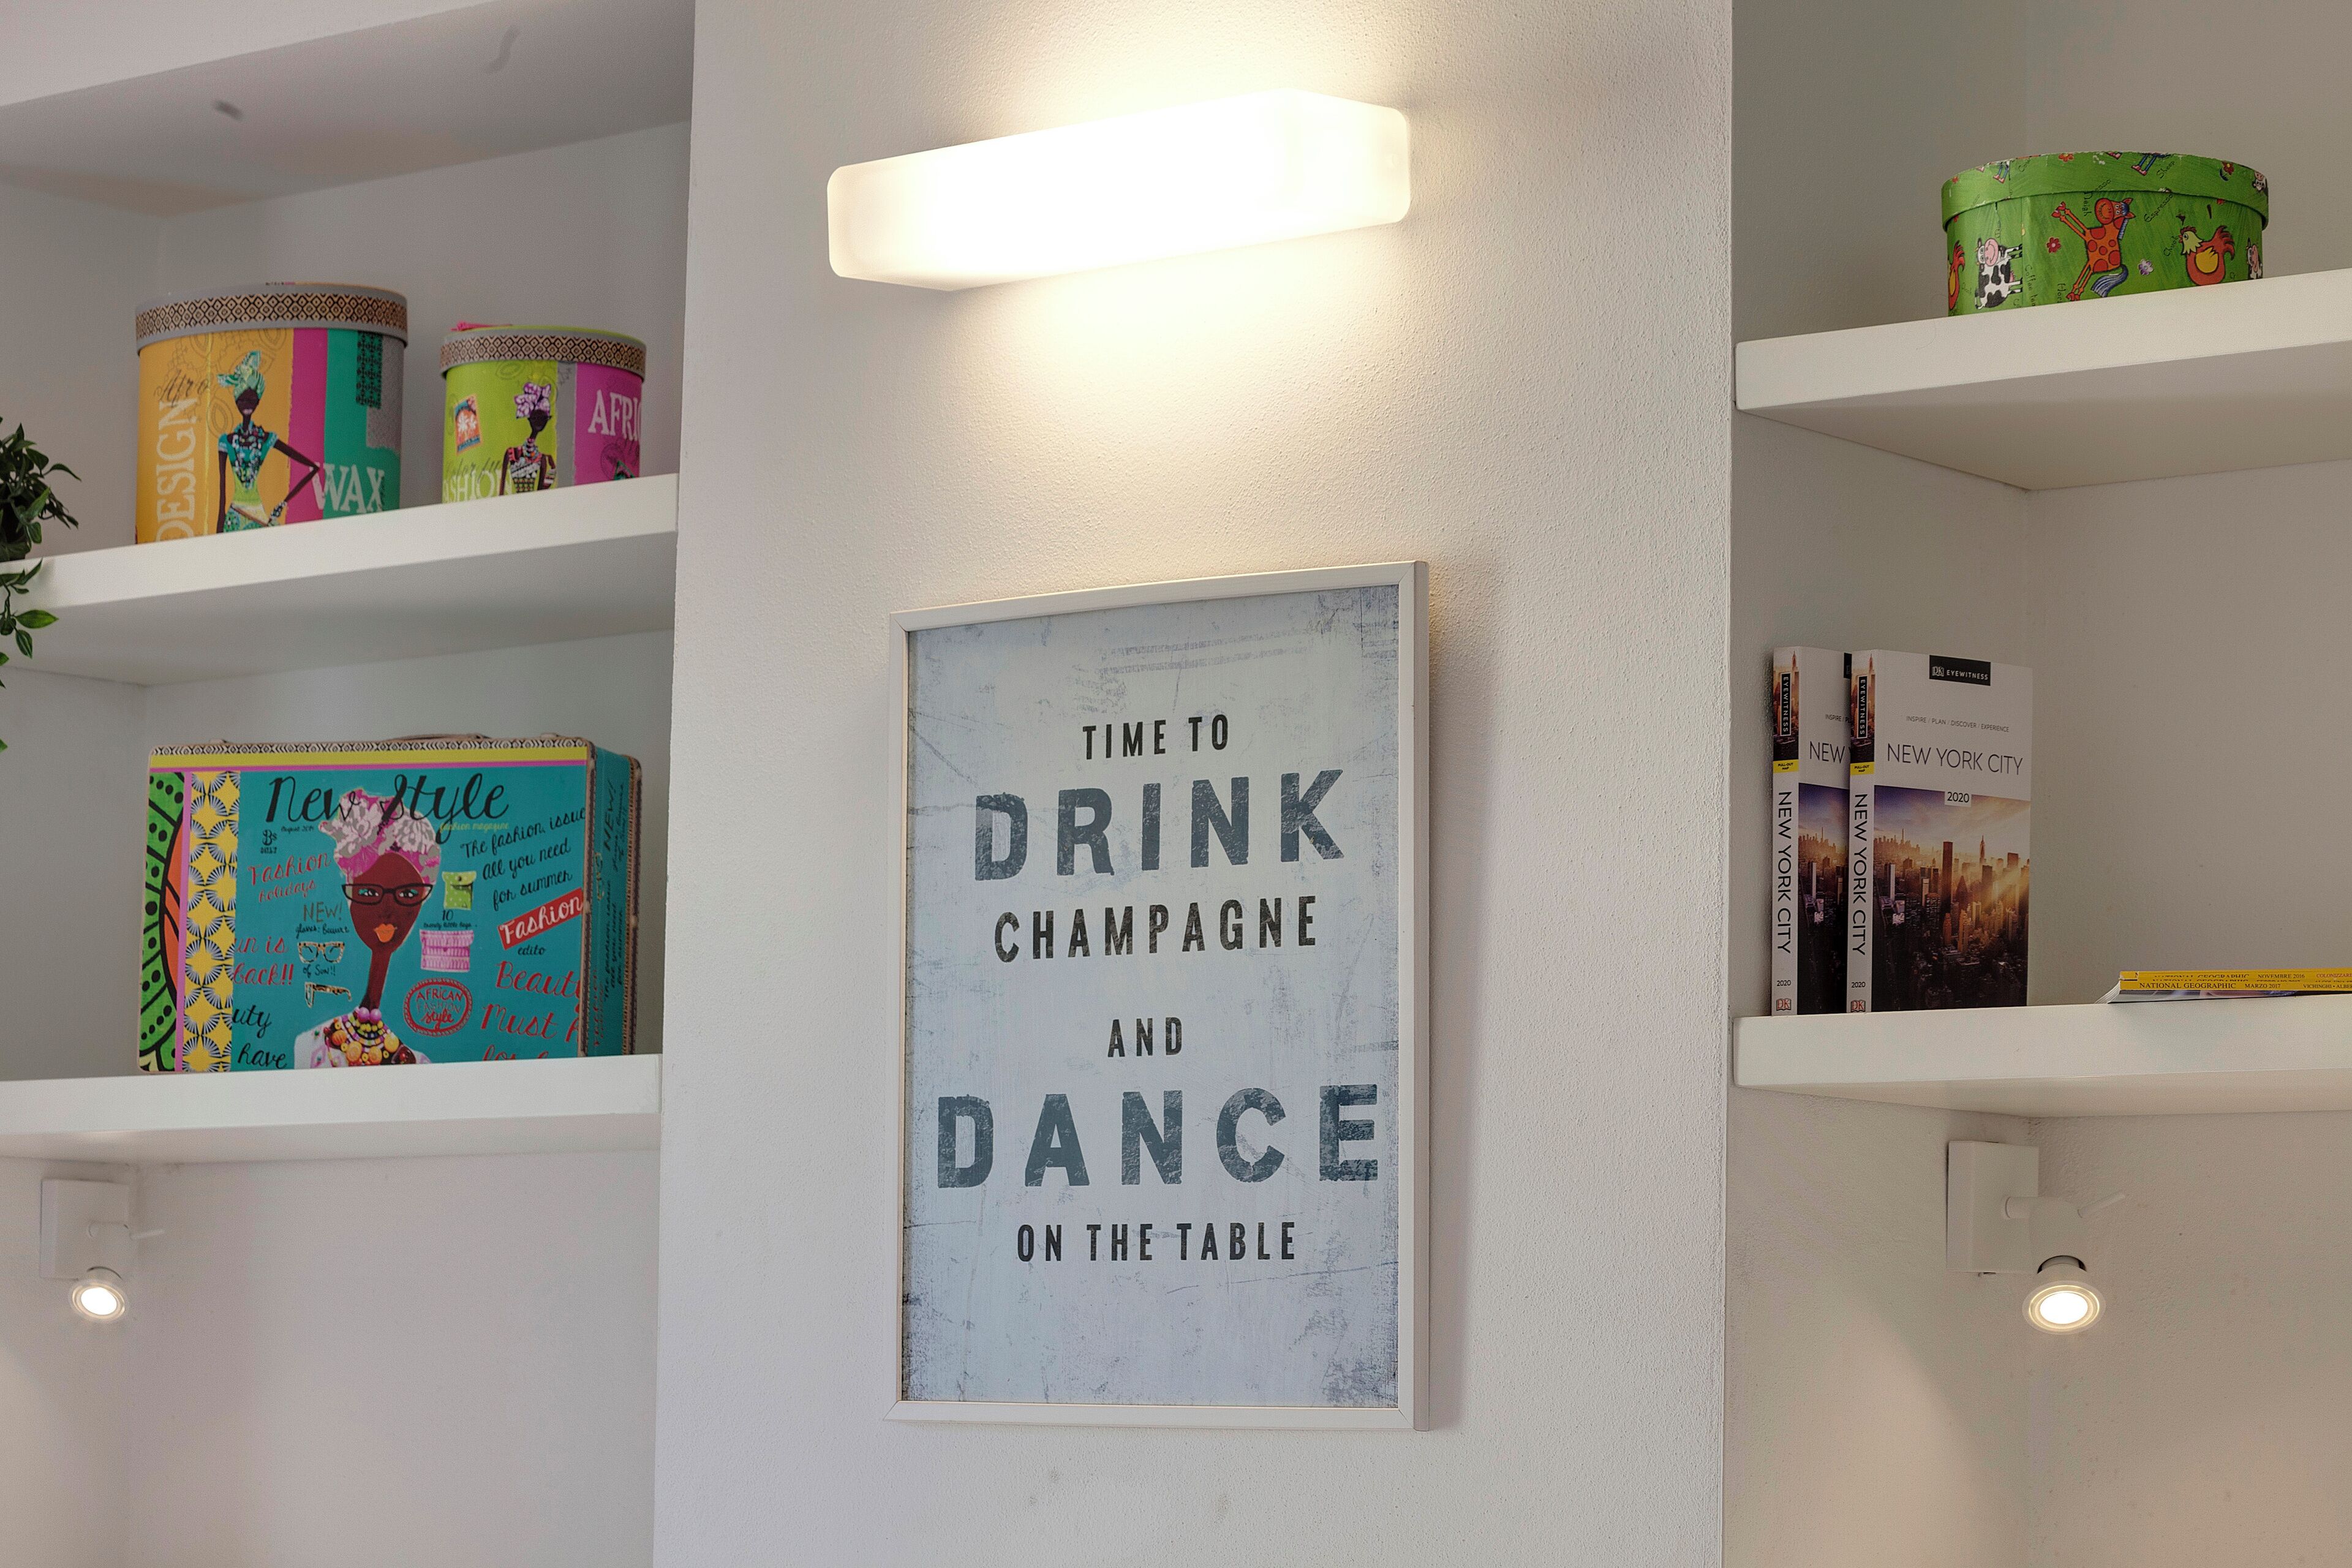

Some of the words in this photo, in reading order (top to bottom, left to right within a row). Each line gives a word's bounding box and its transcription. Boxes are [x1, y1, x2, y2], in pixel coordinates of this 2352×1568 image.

[2144, 194, 2173, 222] Espresso
[309, 461, 385, 514] WAX
[1946, 669, 1989, 680] EYEWITNESS
[1083, 720, 1167, 760] TIME
[1188, 714, 1229, 752] TO
[1950, 720, 1977, 729] DISCOVER
[1980, 723, 2010, 733] EXPERIENCE
[1809, 741, 1846, 764] NEW
[1887, 742, 1932, 766] NEW
[1936, 747, 1984, 772] YORK
[1988, 753, 2024, 776] CITY
[376, 772, 510, 845] Style
[1778, 791, 1792, 840] NEW
[1854, 793, 1868, 842] NEW
[1947, 791, 1970, 804] 2020
[974, 769, 1345, 881] DRINK
[247, 852, 332, 886] Fashion
[460, 839, 488, 858] The
[483, 859, 505, 880] all
[509, 854, 536, 879] you
[539, 837, 571, 862] need
[259, 880, 316, 903] holidays
[493, 889, 516, 911] for
[520, 870, 573, 896] summer
[1777, 845, 1792, 902] YORK
[1853, 846, 1868, 905] YORK
[303, 902, 342, 923] NEW!
[442, 910, 454, 921] 10
[499, 895, 582, 944] Fashion
[994, 895, 1316, 962] CHAMPAGNE
[1777, 908, 1791, 954] CITY
[1852, 910, 1866, 956] CITY
[266, 935, 289, 954] is
[481, 1004, 558, 1039] Must
[1777, 998, 1792, 1010] DK
[1851, 1000, 1866, 1012] DK
[238, 1042, 287, 1069] have
[1107, 1016, 1183, 1058] AND
[937, 1084, 1379, 1188] DANCE
[1017, 1224, 1062, 1262] ON
[1087, 1223, 1153, 1261] THE
[1176, 1221, 1295, 1261] TABLE
